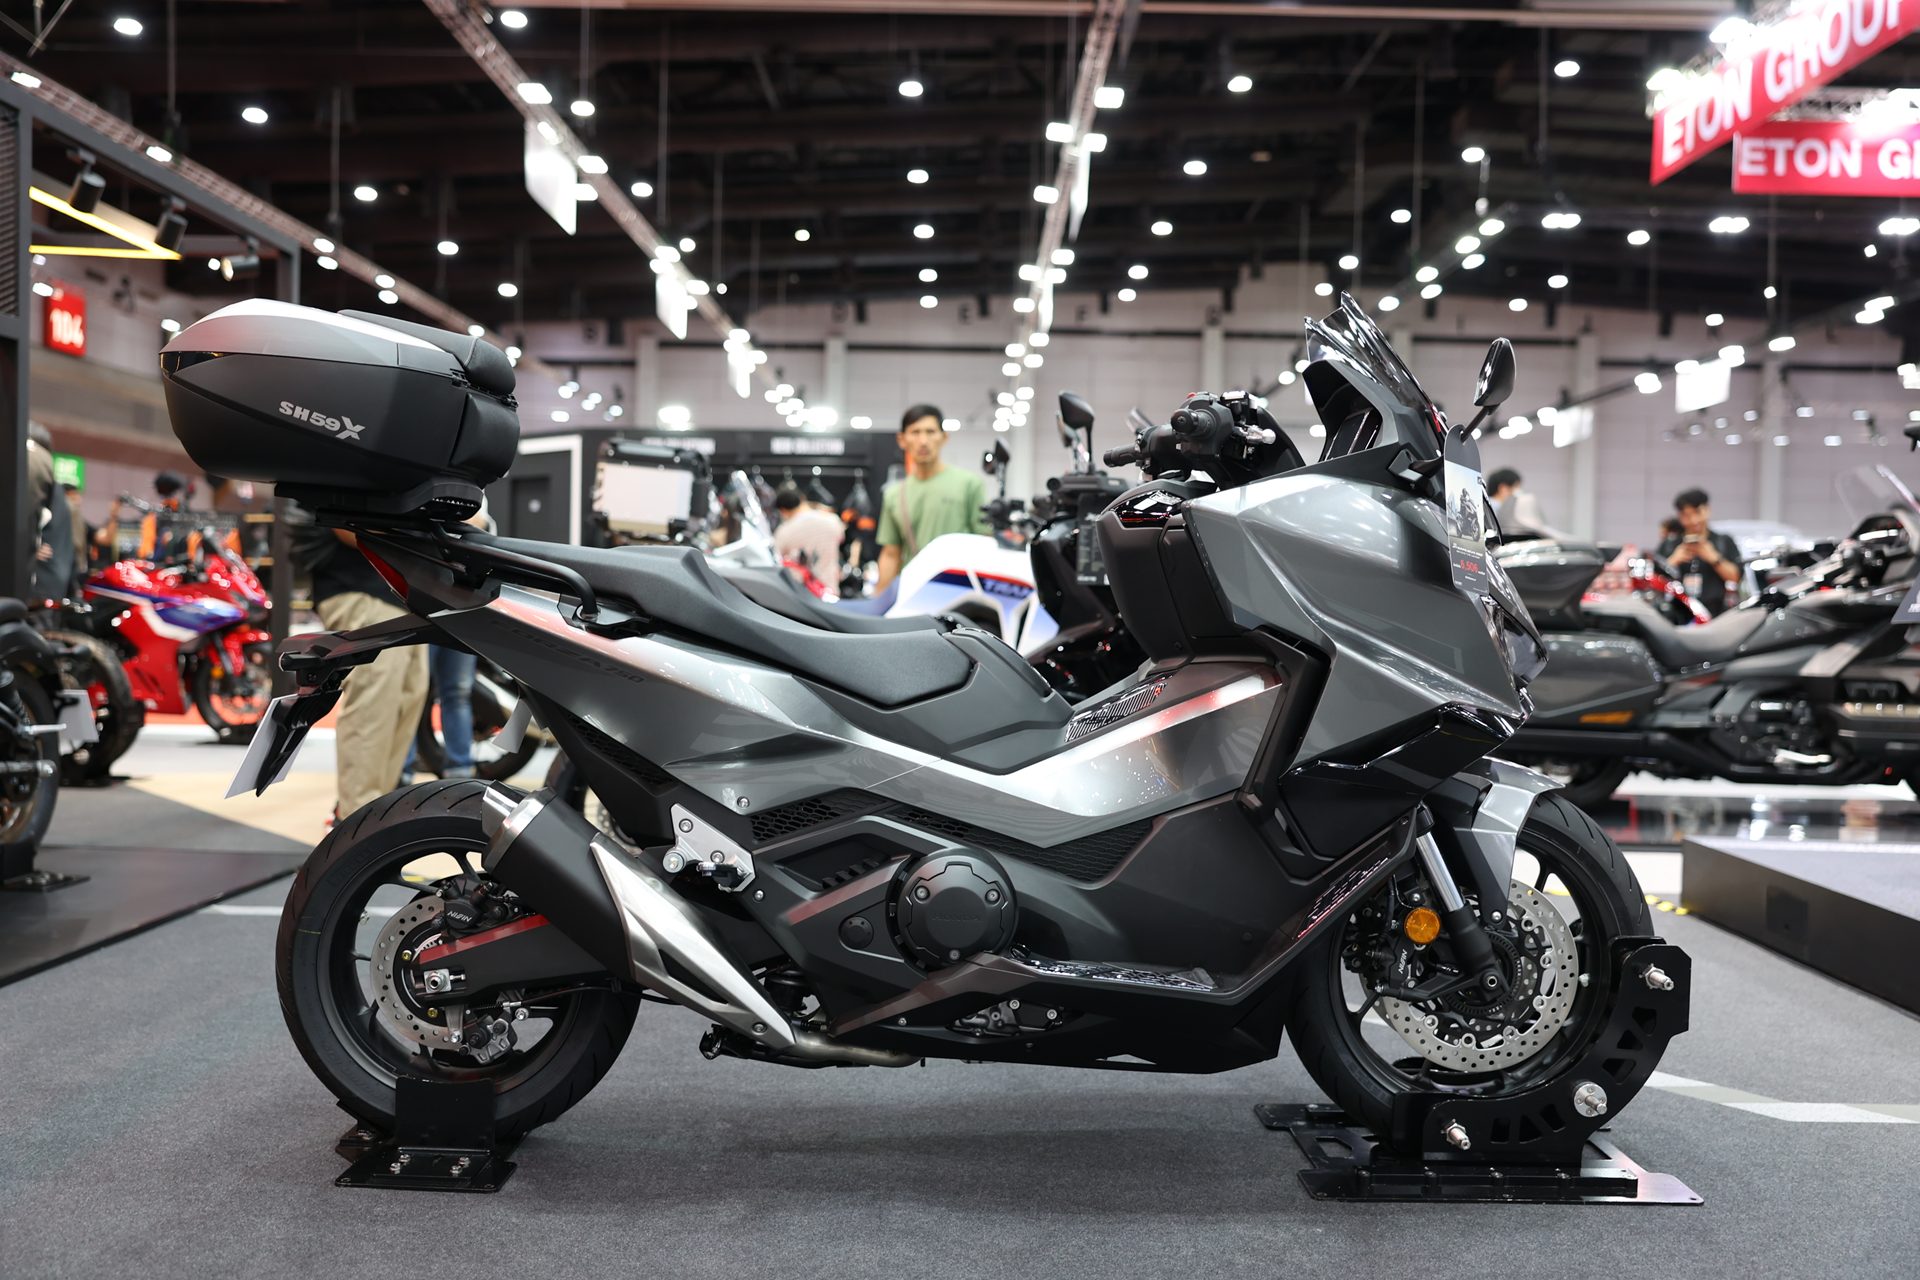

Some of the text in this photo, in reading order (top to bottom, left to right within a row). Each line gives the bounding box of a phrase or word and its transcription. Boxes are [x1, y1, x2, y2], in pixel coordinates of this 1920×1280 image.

[1739, 138, 1920, 181] ETON G
[279, 400, 366, 441] SH59X
